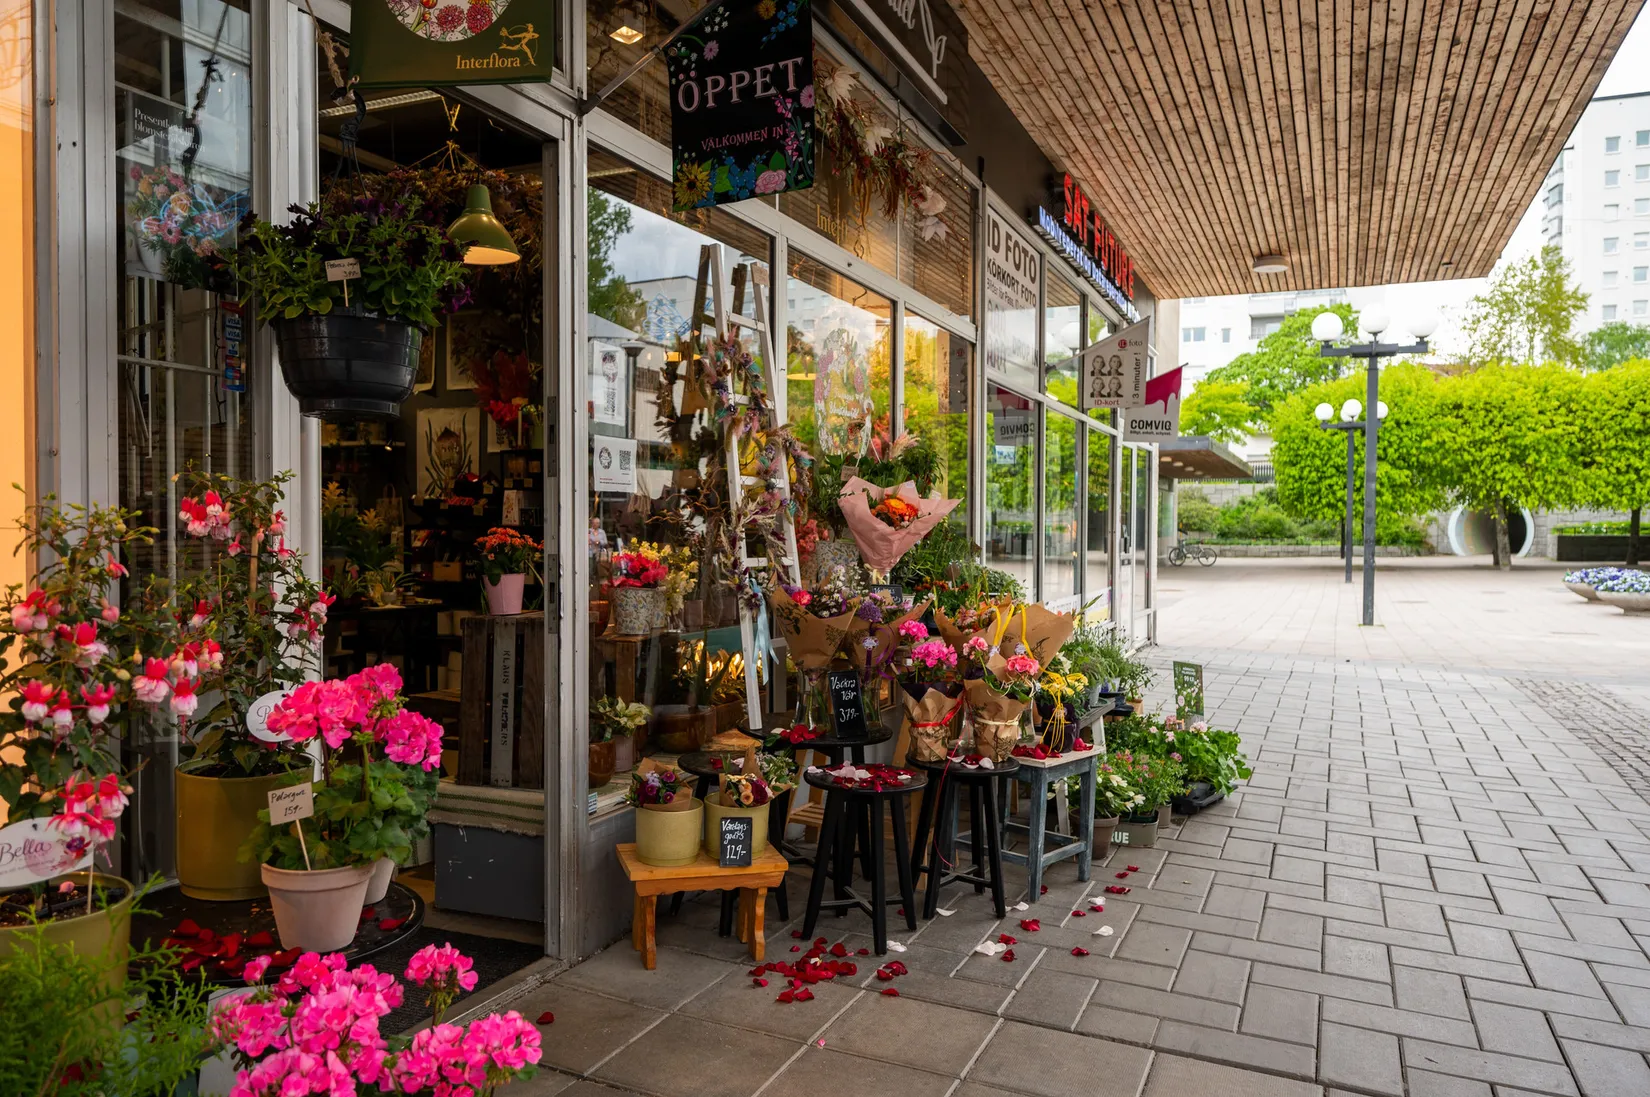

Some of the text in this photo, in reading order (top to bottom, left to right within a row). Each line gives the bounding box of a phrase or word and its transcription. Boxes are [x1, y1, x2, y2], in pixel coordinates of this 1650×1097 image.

[456, 52, 521, 69] Interflora
[678, 56, 804, 112] ÖPPET
[701, 123, 785, 151] VÄLKOMMEN IN
[987, 213, 1038, 284] ID FOTO
[1063, 172, 1090, 247] SAT
[1093, 211, 1135, 301] FUTURE
[986, 255, 1037, 308] KÖRKORT FOTO
[1128, 338, 1143, 347] foto
[1132, 358, 1142, 392] minuter
[1094, 399, 1120, 407] ID-kort
[1130, 419, 1172, 431] COMVIQ
[502, 650, 511, 685] KLAUS
